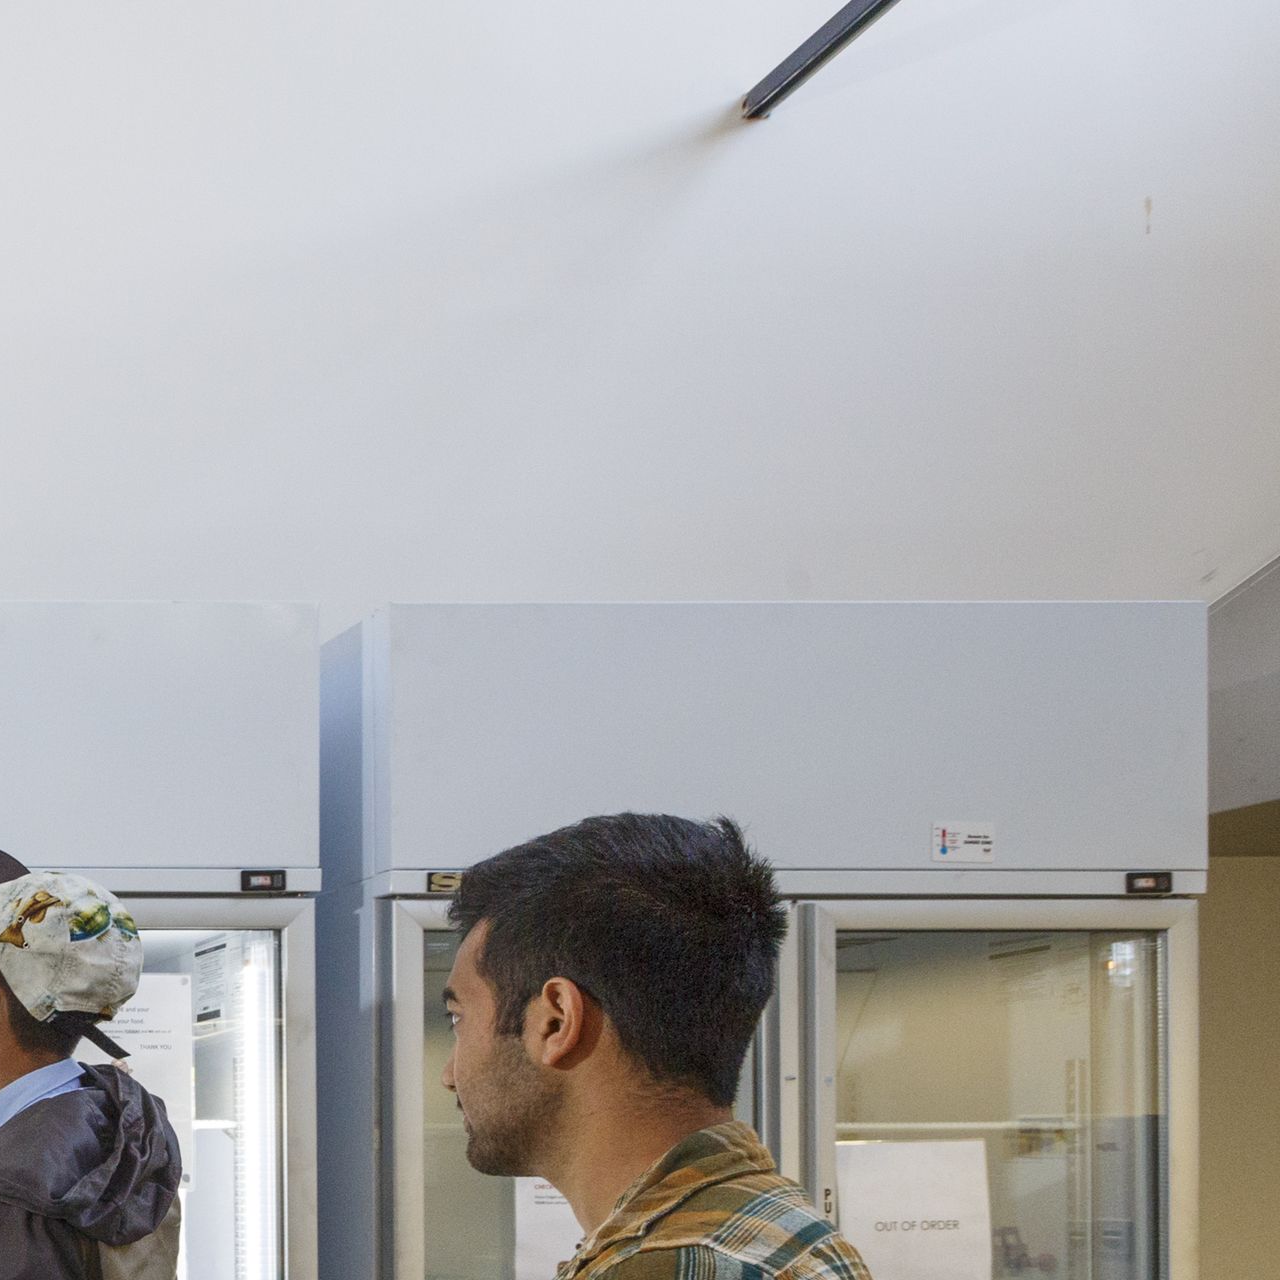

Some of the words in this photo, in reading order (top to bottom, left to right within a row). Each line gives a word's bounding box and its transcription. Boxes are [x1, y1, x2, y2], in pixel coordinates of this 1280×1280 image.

[824, 1189, 832, 1218] PU
[875, 1222, 899, 1232] OUT
[901, 1221, 916, 1231] OF
[921, 1220, 960, 1230] ORDER
